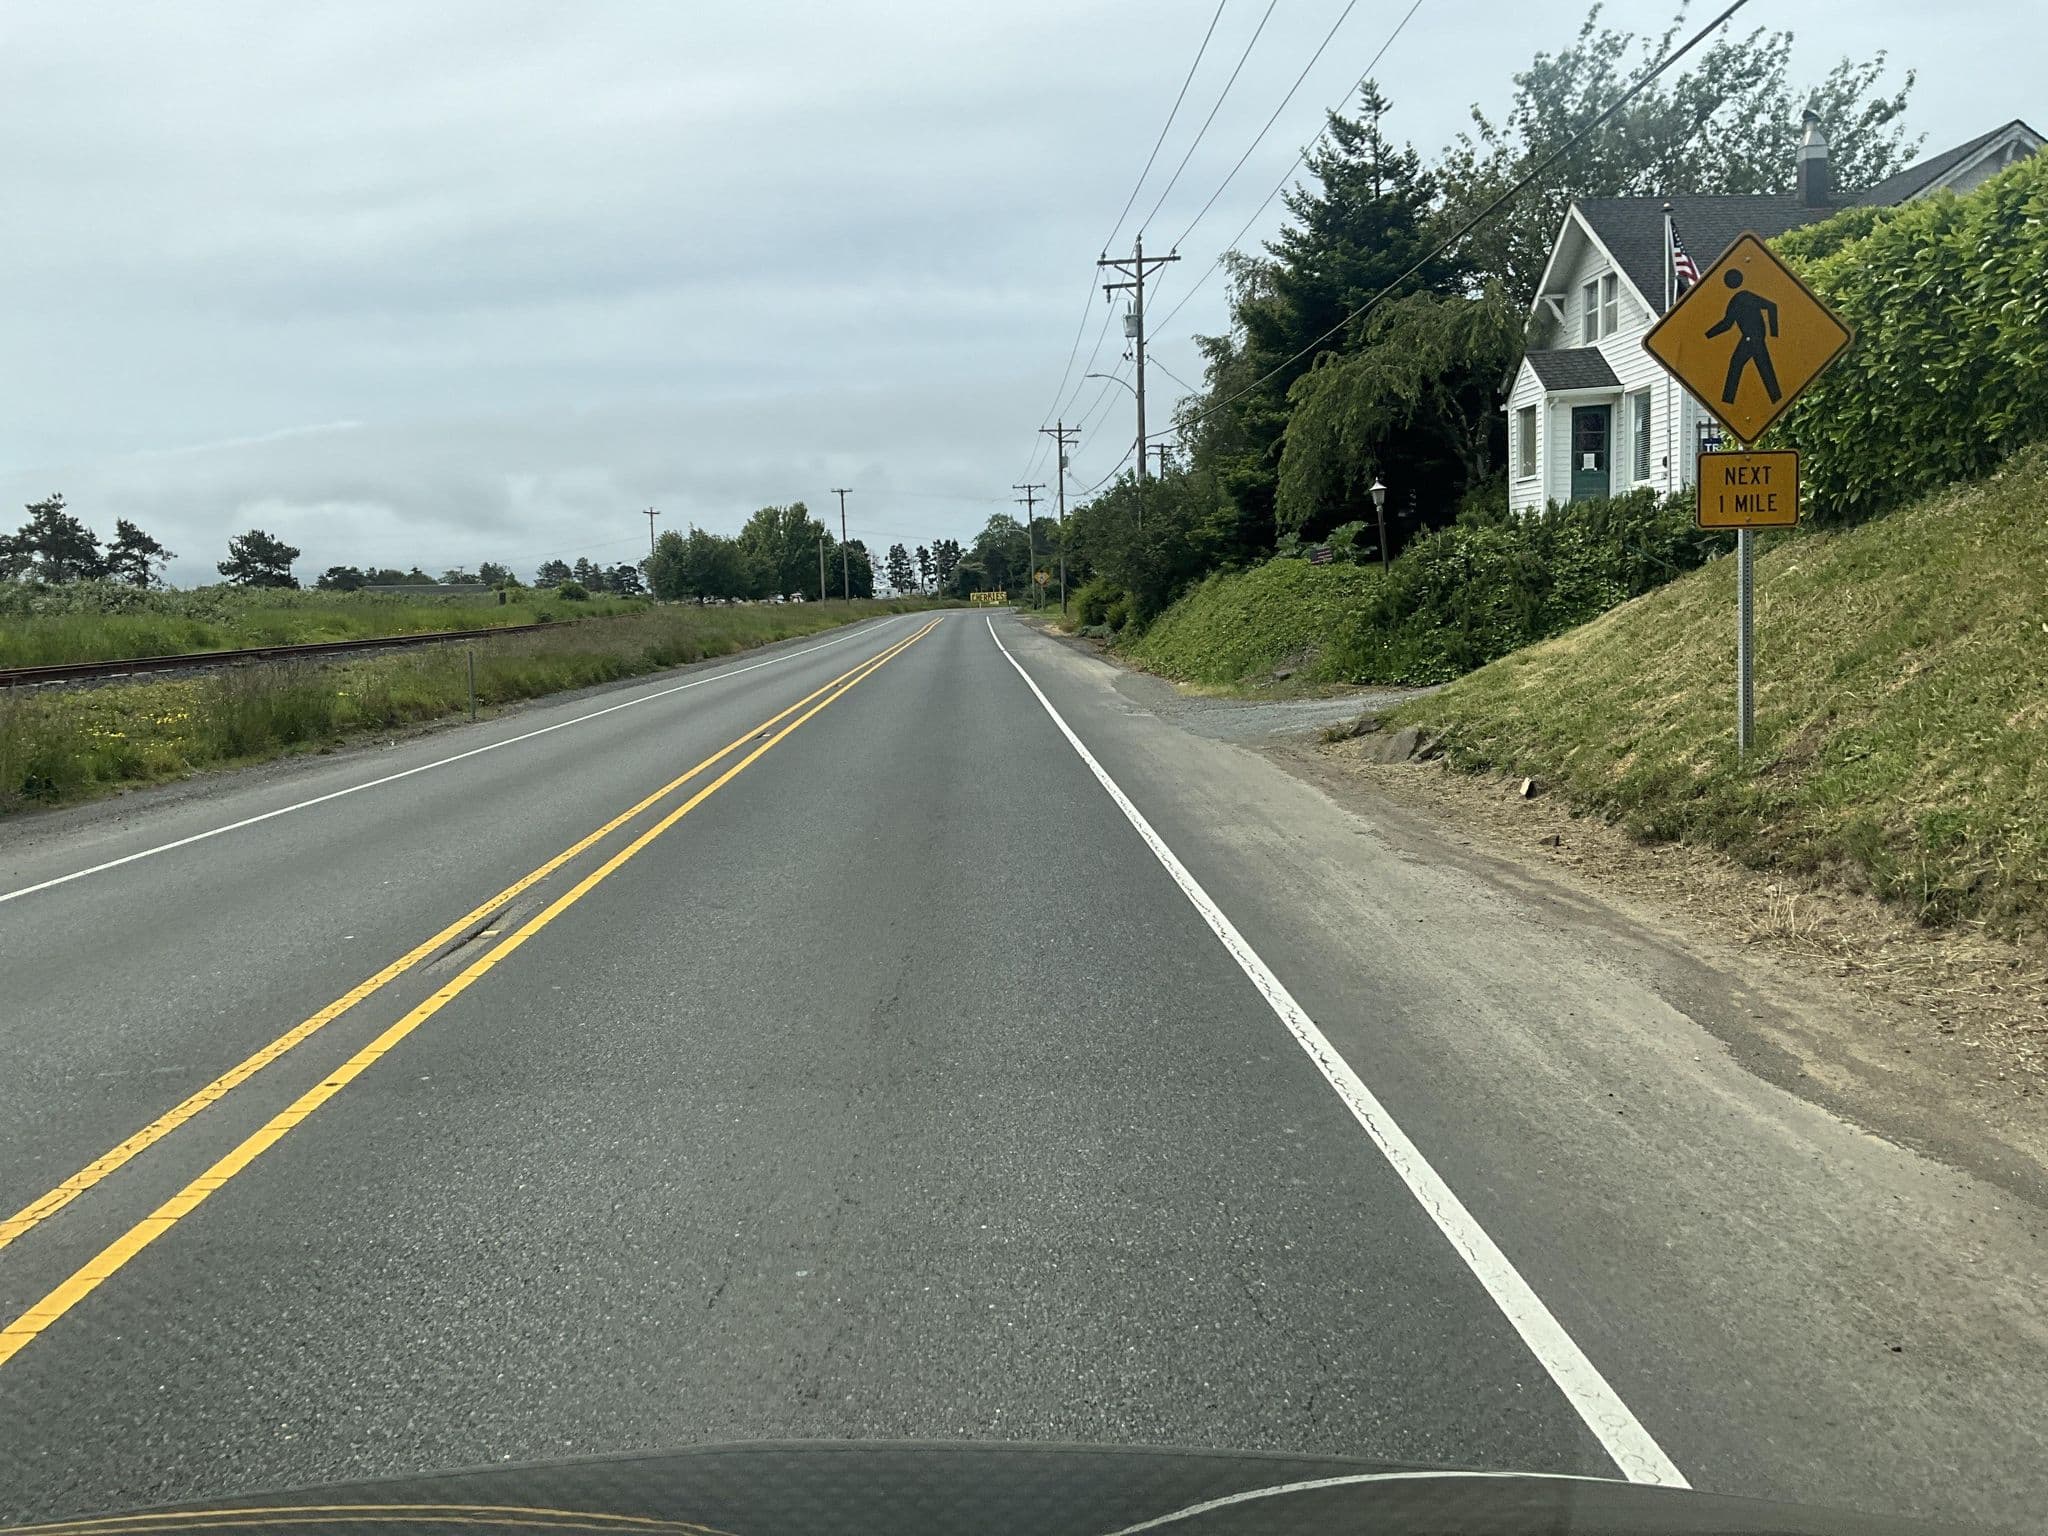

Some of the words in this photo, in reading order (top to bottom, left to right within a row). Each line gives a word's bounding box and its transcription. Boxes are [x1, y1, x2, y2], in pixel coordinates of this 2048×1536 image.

[1725, 466, 1771, 485] NEXT
[1719, 495, 1724, 513] 1
[1735, 493, 1778, 513] MILE
